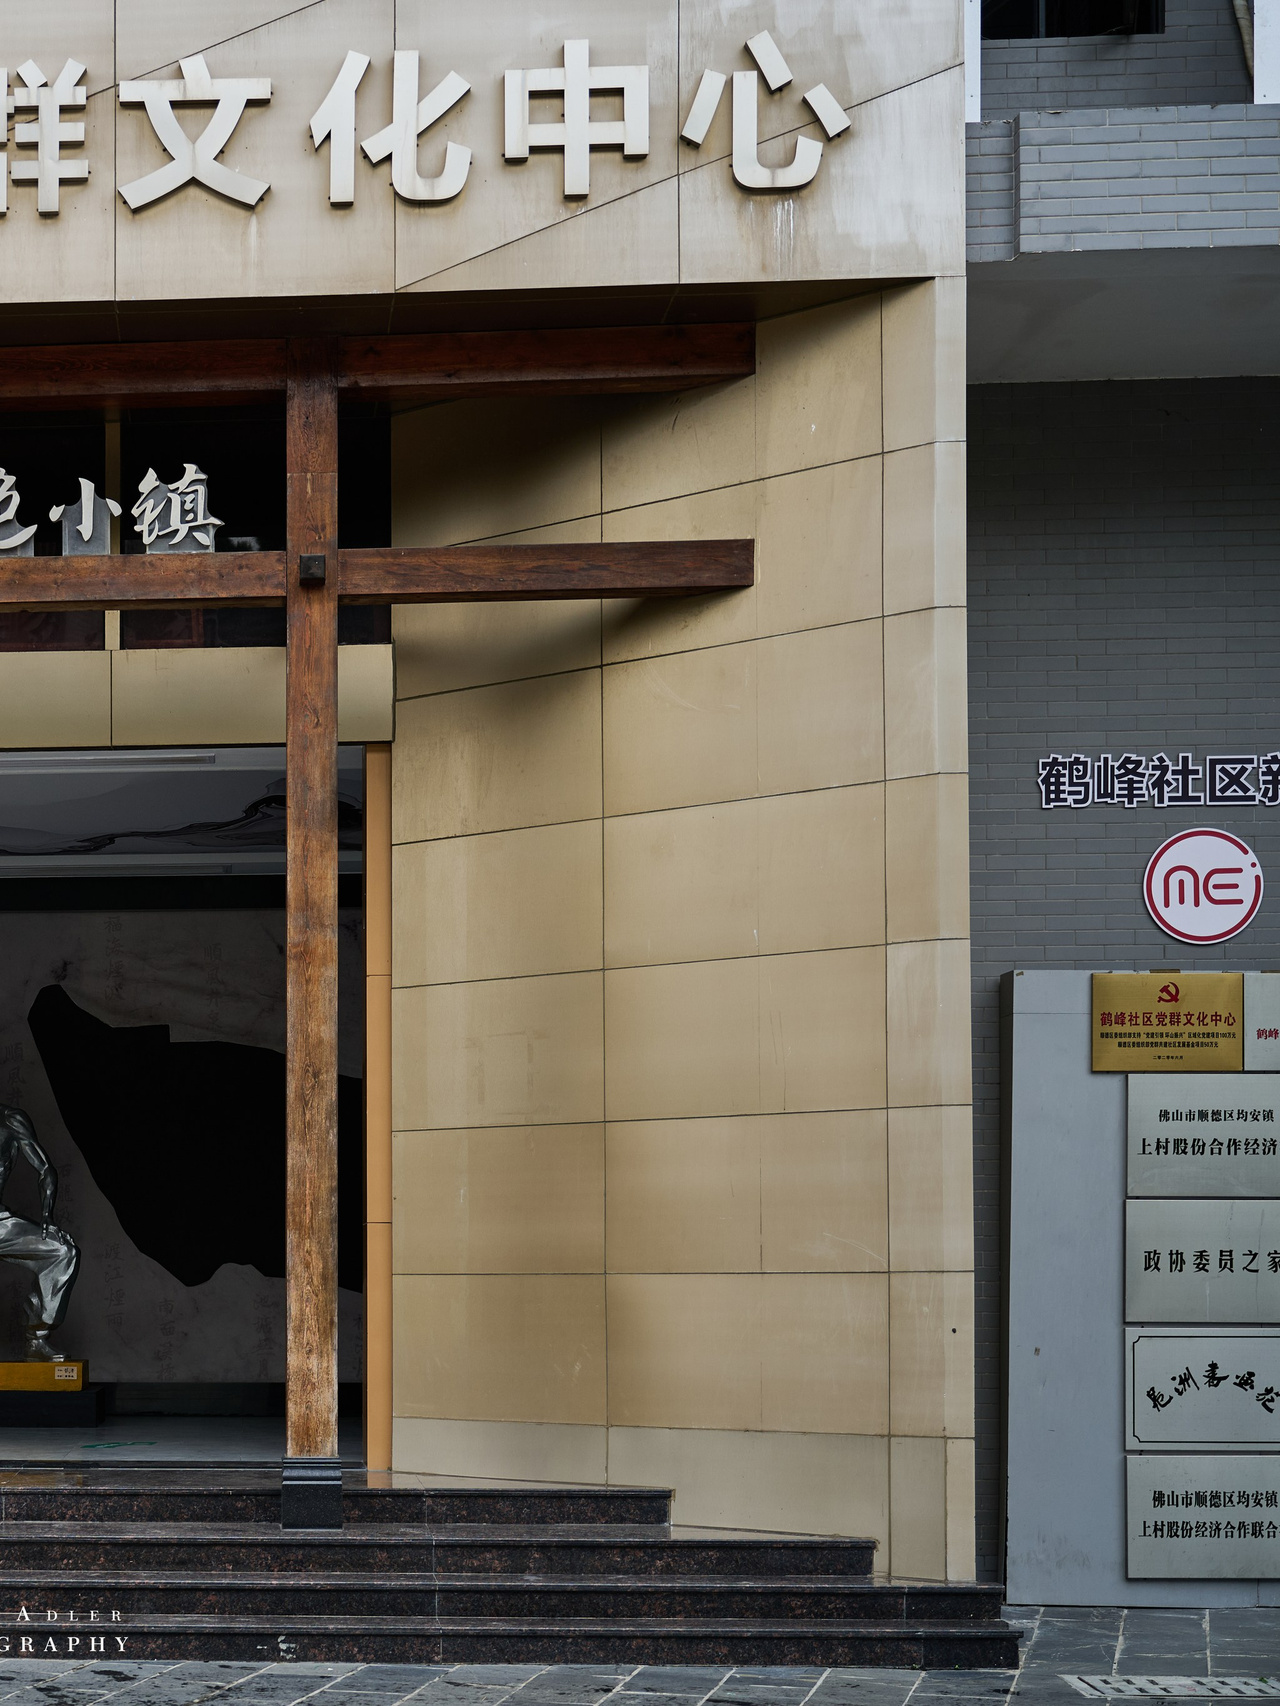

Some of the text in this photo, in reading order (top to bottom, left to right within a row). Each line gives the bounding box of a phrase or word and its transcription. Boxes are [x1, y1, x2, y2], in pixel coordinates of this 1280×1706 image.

[1100, 1011, 1237, 1027] 鹤峰社区党群文化中心
[1158, 1109, 1275, 1122] 佛山市顺德区均安镇
[1137, 1137, 1279, 1155] 上村股份合作经济
[1143, 1249, 1280, 1273] 政协委员之家
[1152, 1490, 1278, 1508] 佛山市顺德区均安镇
[1138, 1521, 1280, 1539] 上村股份经济合作联合
